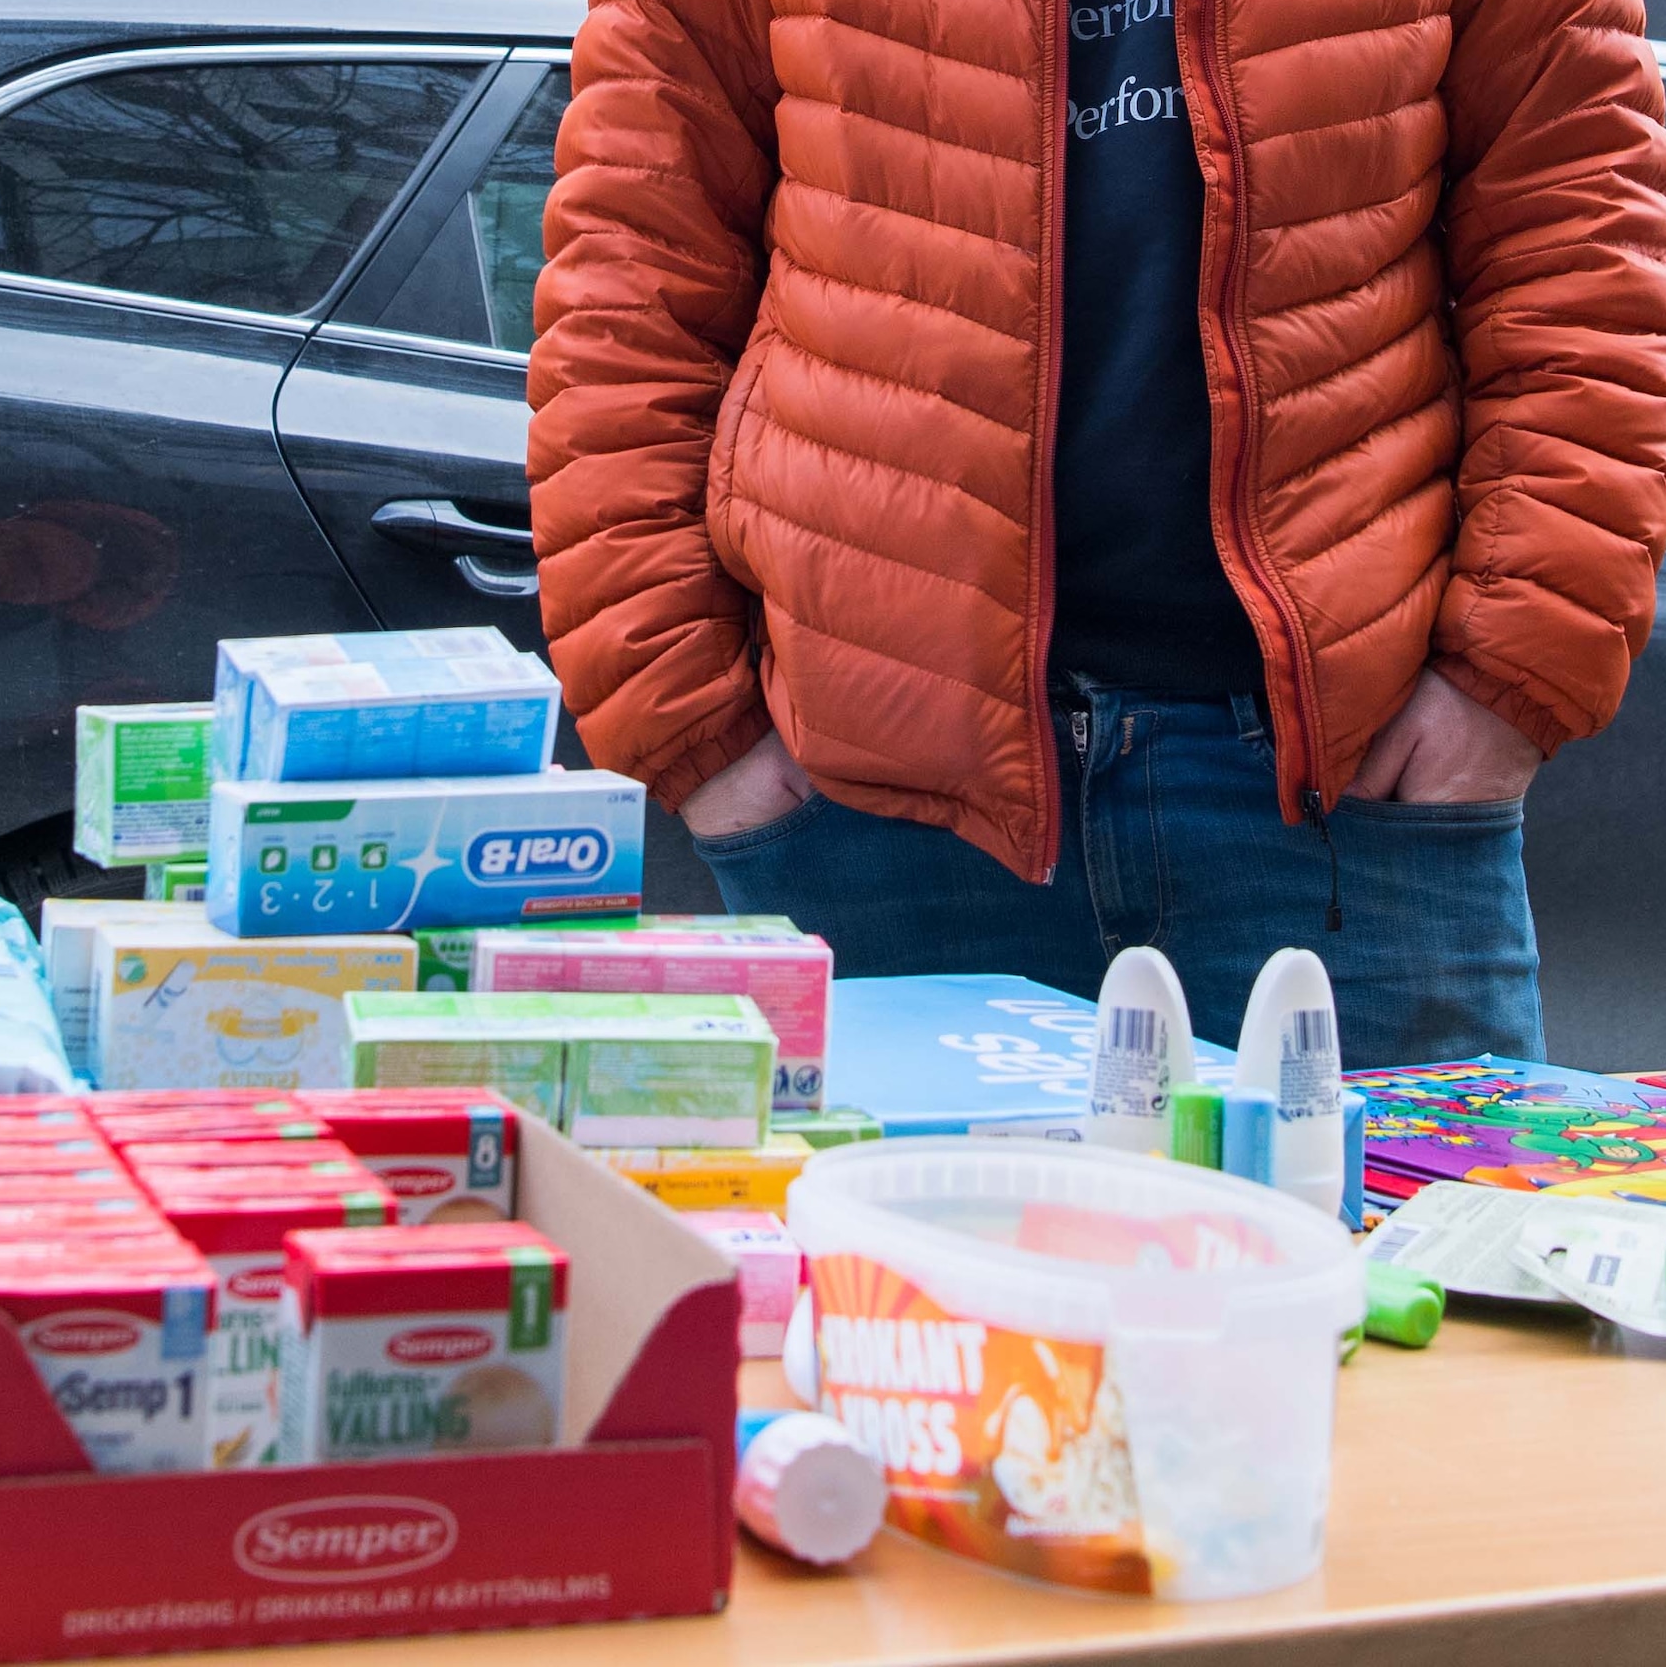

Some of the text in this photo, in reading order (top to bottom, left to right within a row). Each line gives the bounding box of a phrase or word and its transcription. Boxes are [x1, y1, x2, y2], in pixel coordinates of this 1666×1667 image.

[481, 836, 599, 875] Oral-B
[476, 1136, 496, 1170] 8
[253, 1517, 445, 1563] Semper
